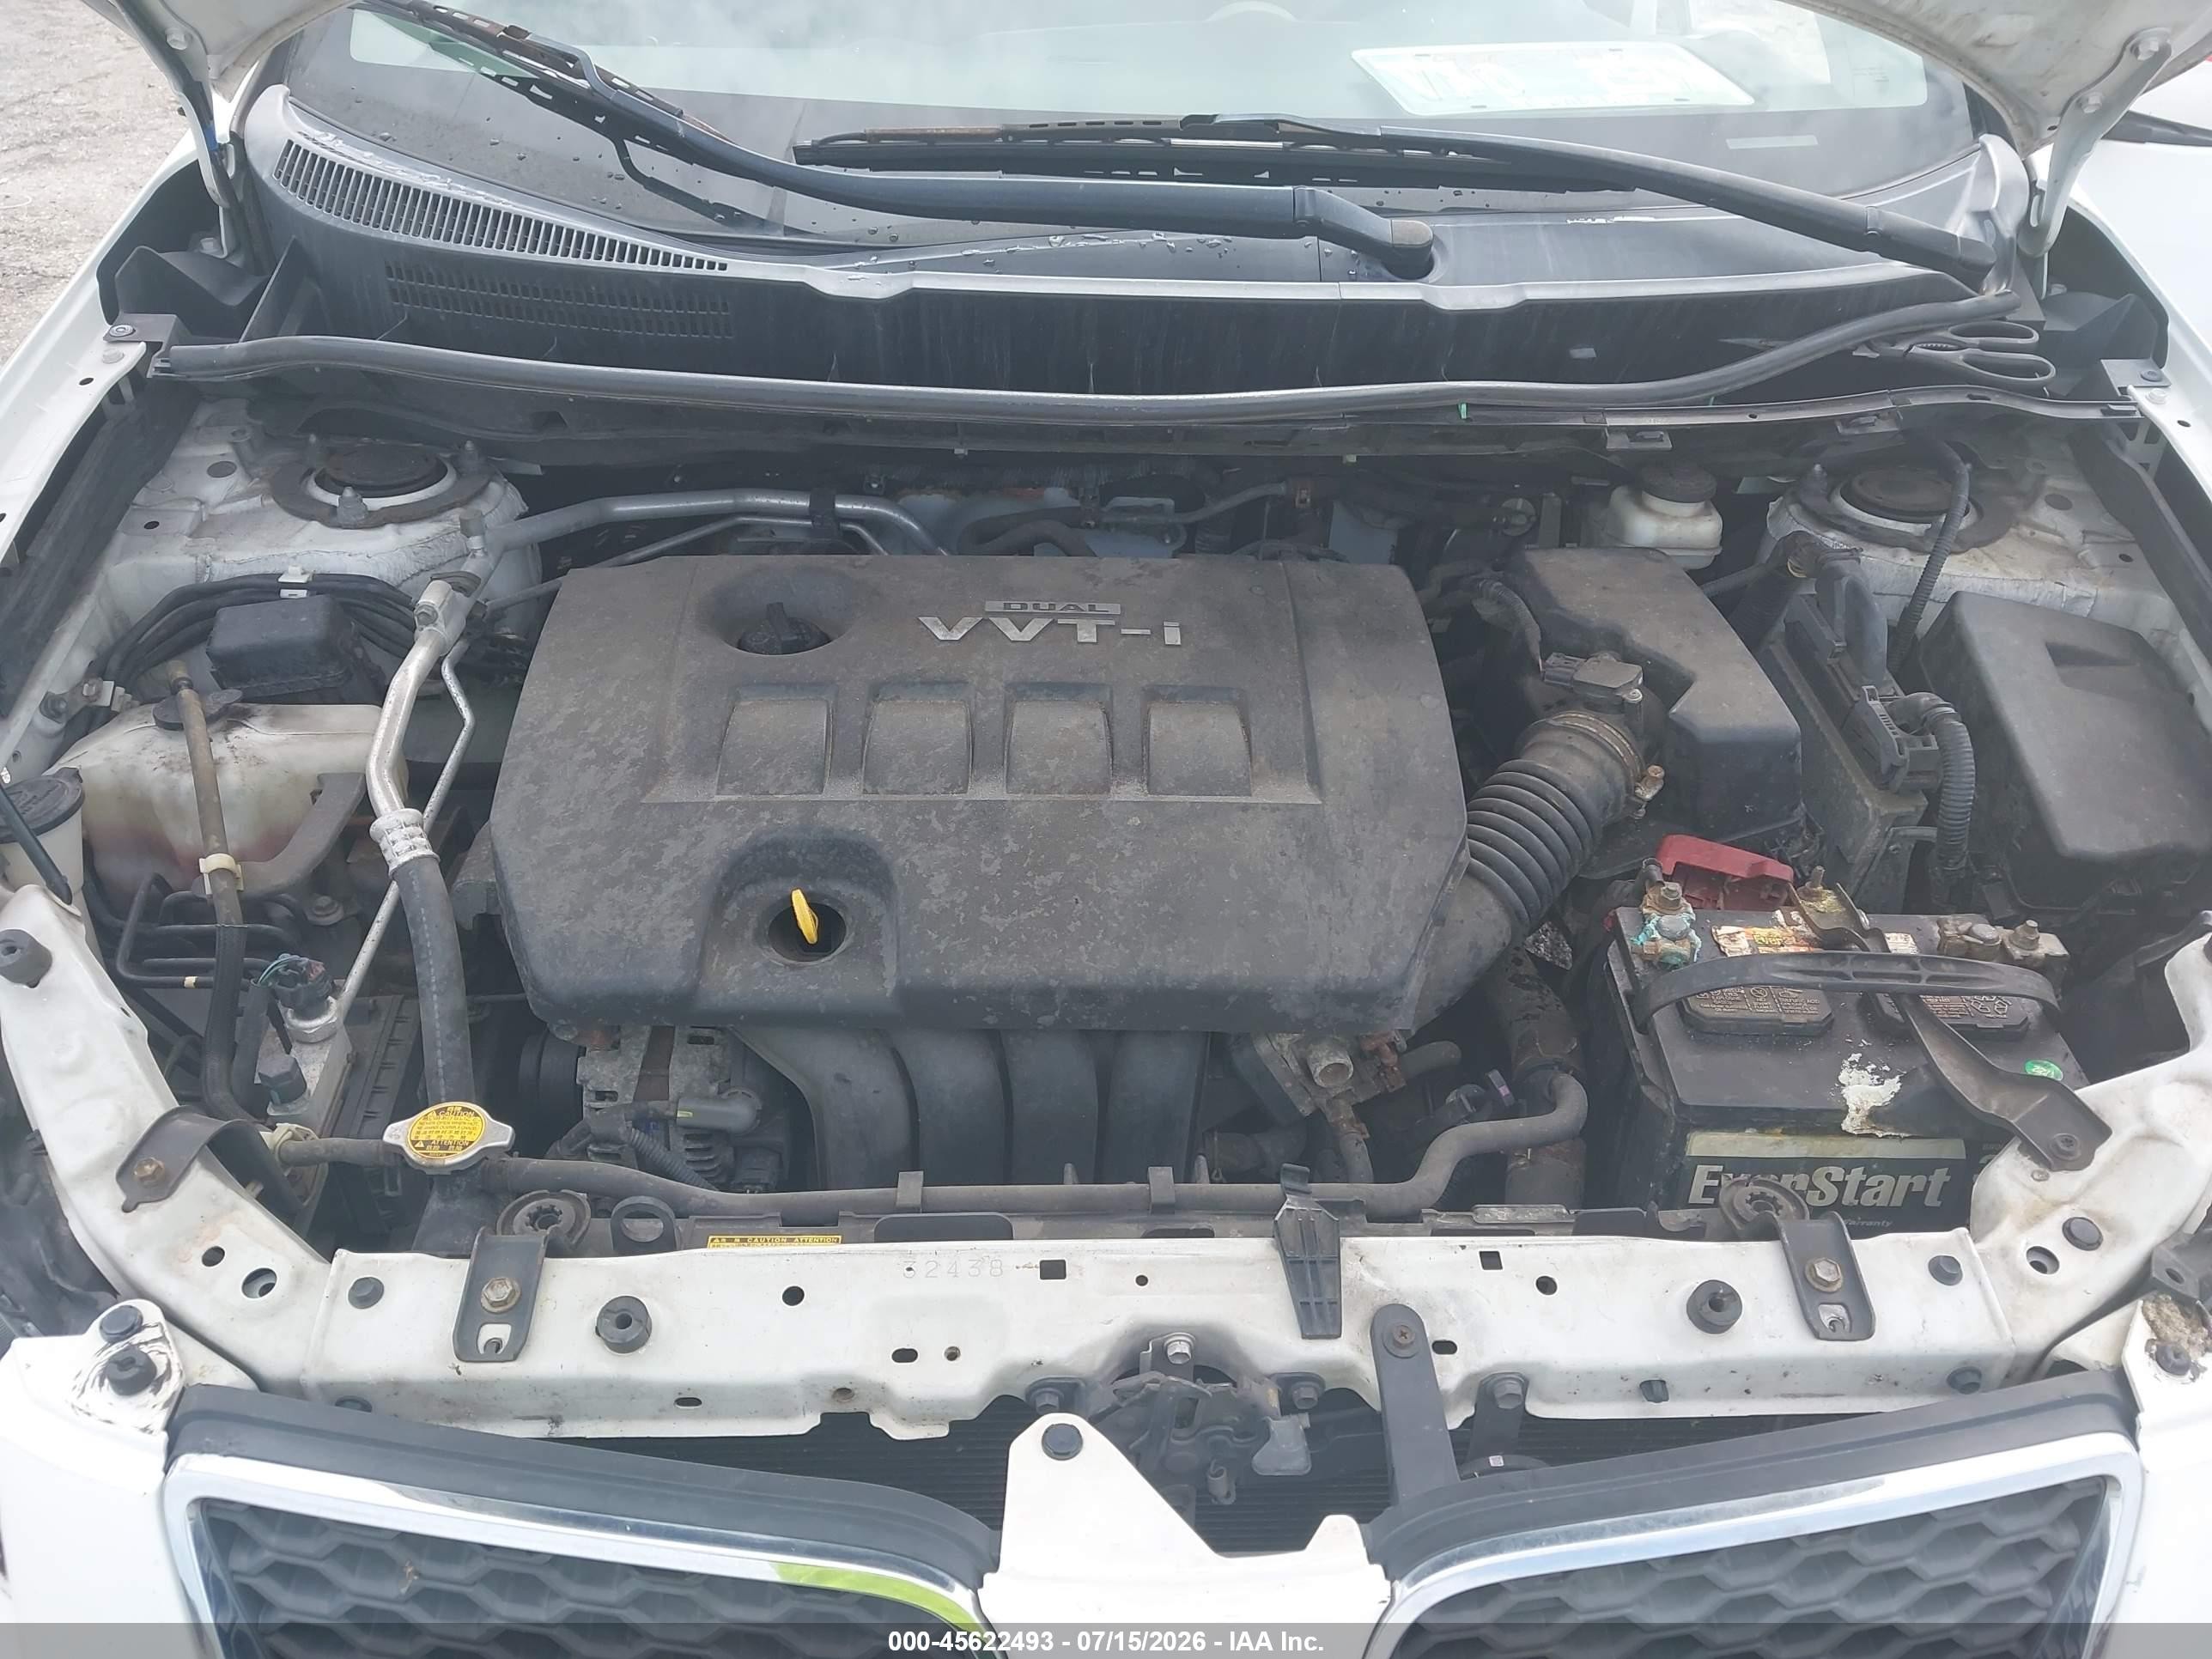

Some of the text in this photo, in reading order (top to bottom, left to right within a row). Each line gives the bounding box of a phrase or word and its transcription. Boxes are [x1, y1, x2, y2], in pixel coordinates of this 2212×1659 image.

[1001, 602, 1109, 612] DUAL
[918, 617, 1182, 646] VVT-i
[1687, 1164, 1952, 1207] ErStart
[902, 1259, 1004, 1279] 32438
